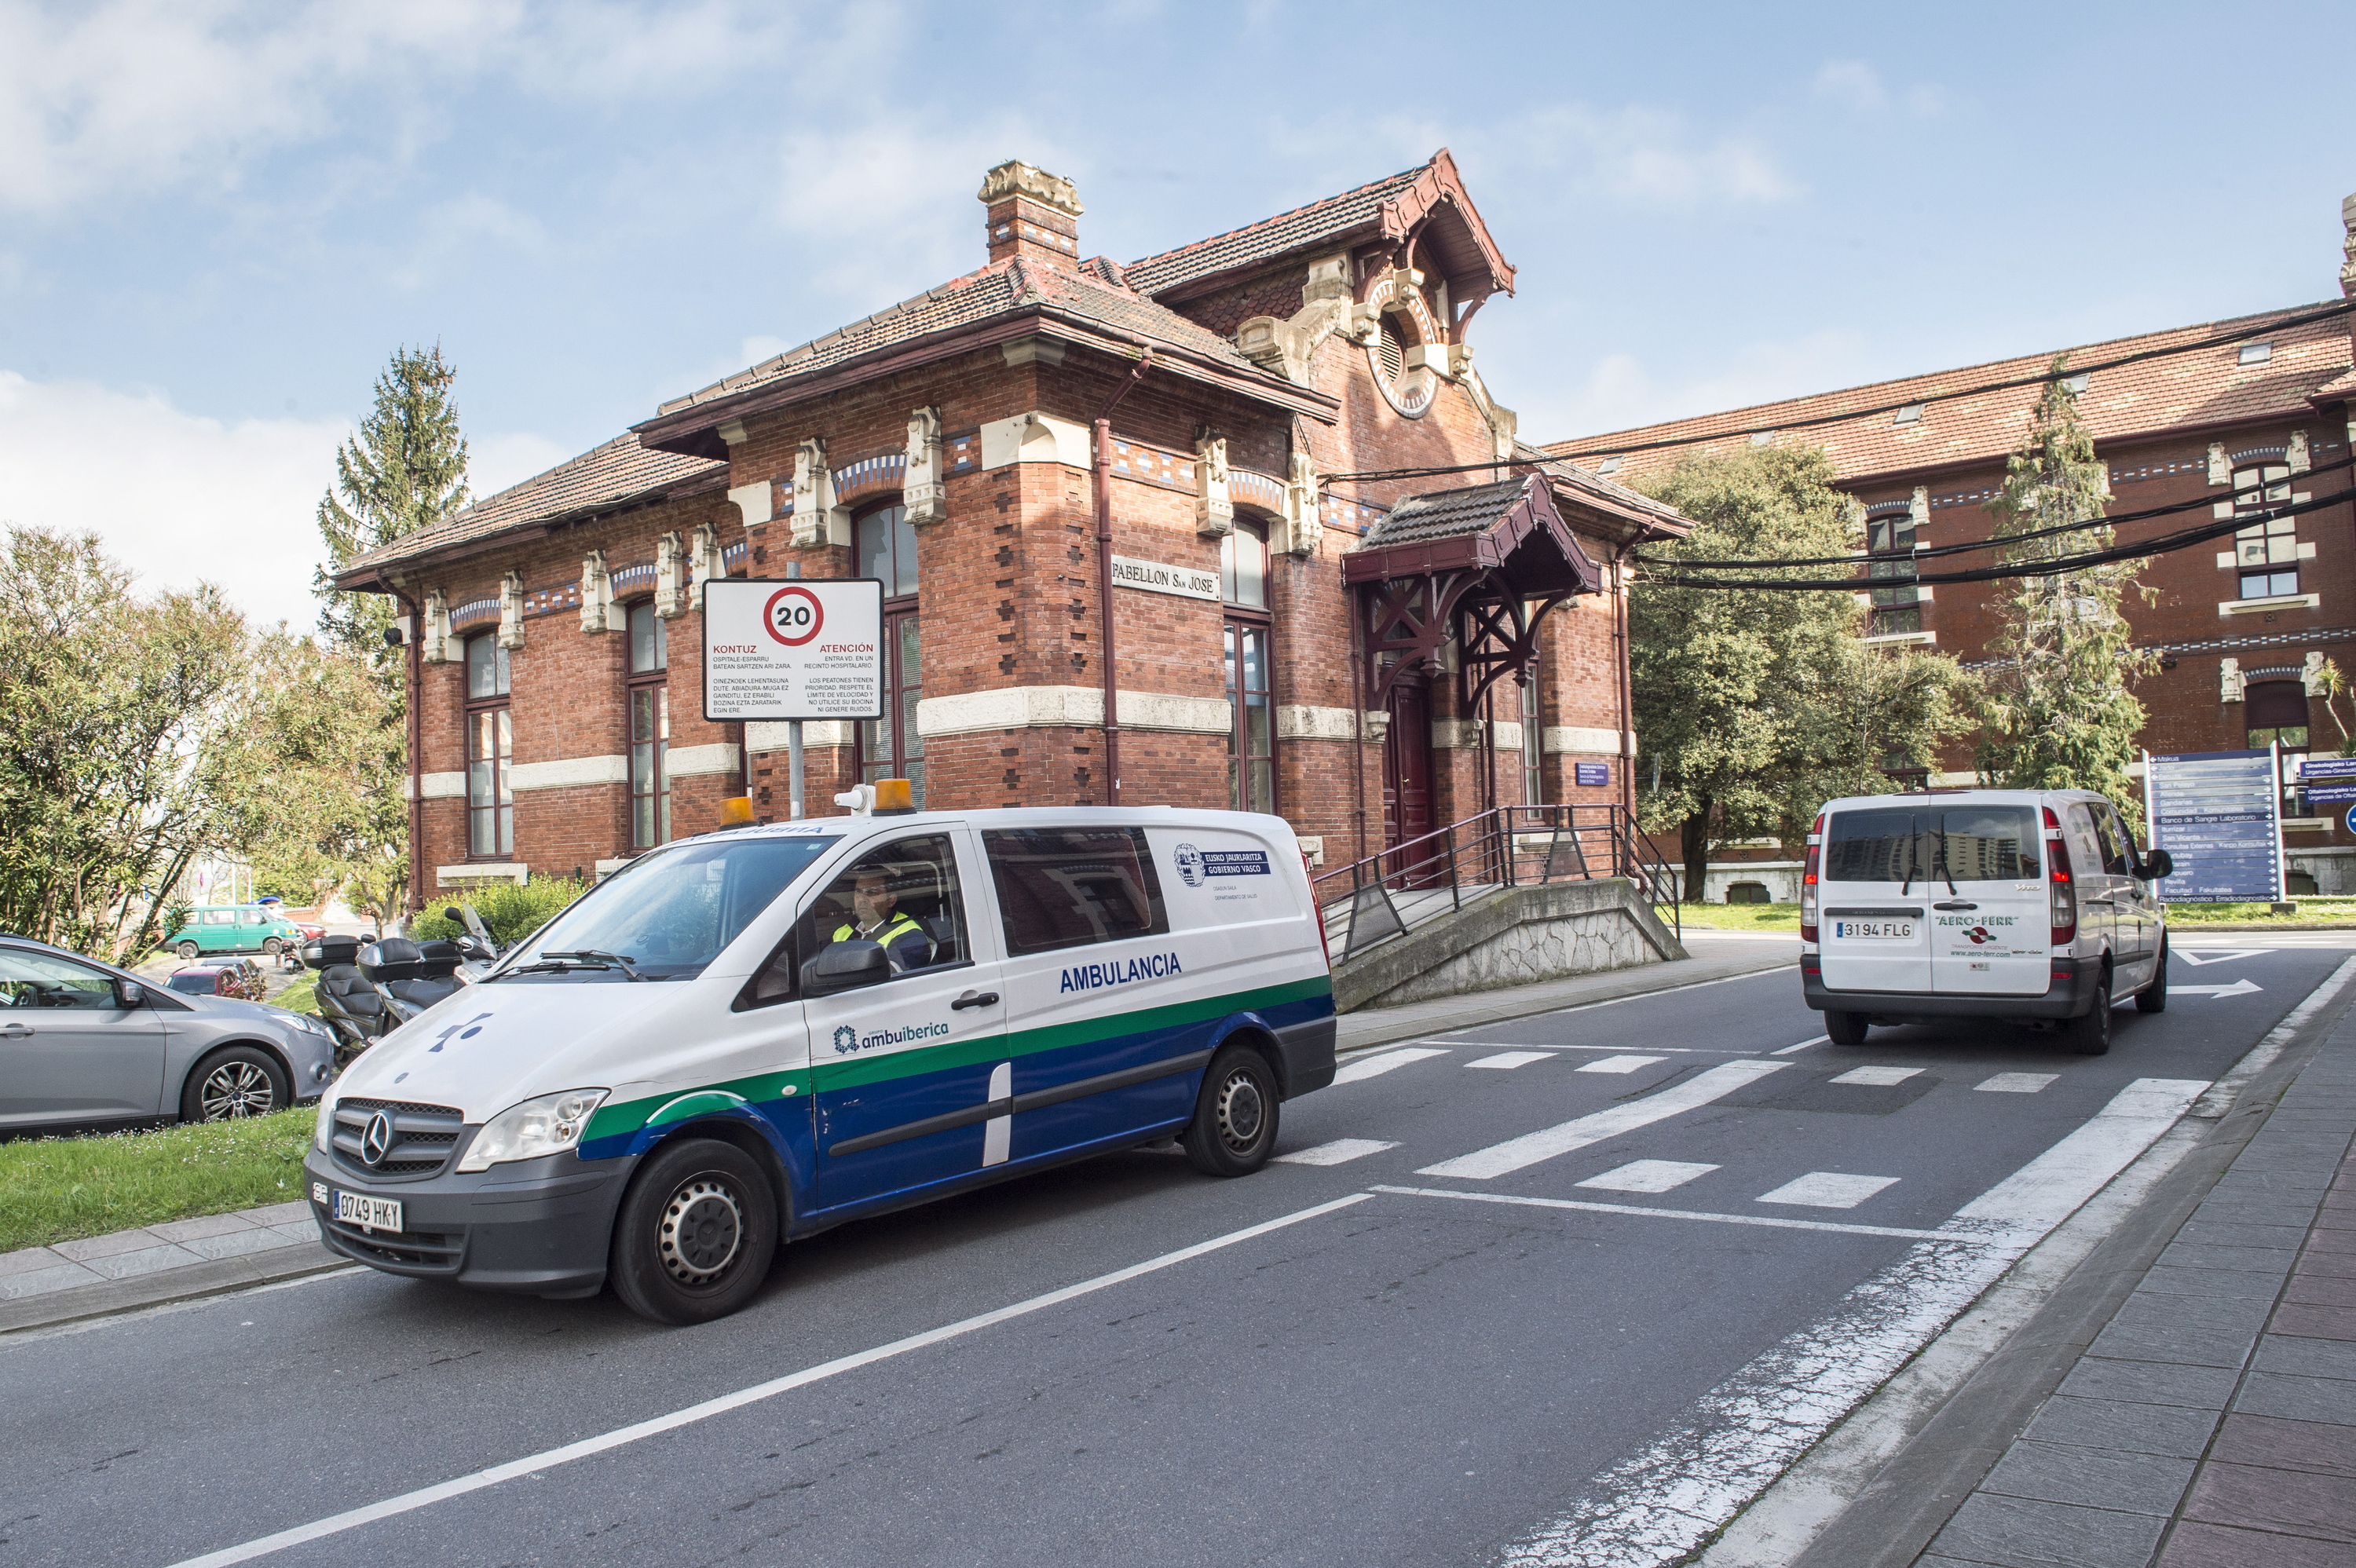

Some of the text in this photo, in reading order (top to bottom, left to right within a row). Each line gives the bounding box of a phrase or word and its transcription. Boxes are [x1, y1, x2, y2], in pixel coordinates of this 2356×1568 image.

[1112, 563, 1168, 586] PABELLON
[1189, 577, 1214, 593] JOSE
[777, 607, 810, 626] 20
[820, 642, 873, 653] ATENCIÓN
[1226, 854, 1262, 862] JAURLARITZA
[1208, 866, 1240, 874] GOBIERNO
[1845, 924, 1879, 936] 3194
[1884, 924, 1910, 936] FLG
[1060, 952, 1182, 994] AMBULANCIA
[862, 1022, 949, 1048] ambuiberica
[342, 1195, 369, 1221] 0749
[374, 1201, 397, 1227] HKY
